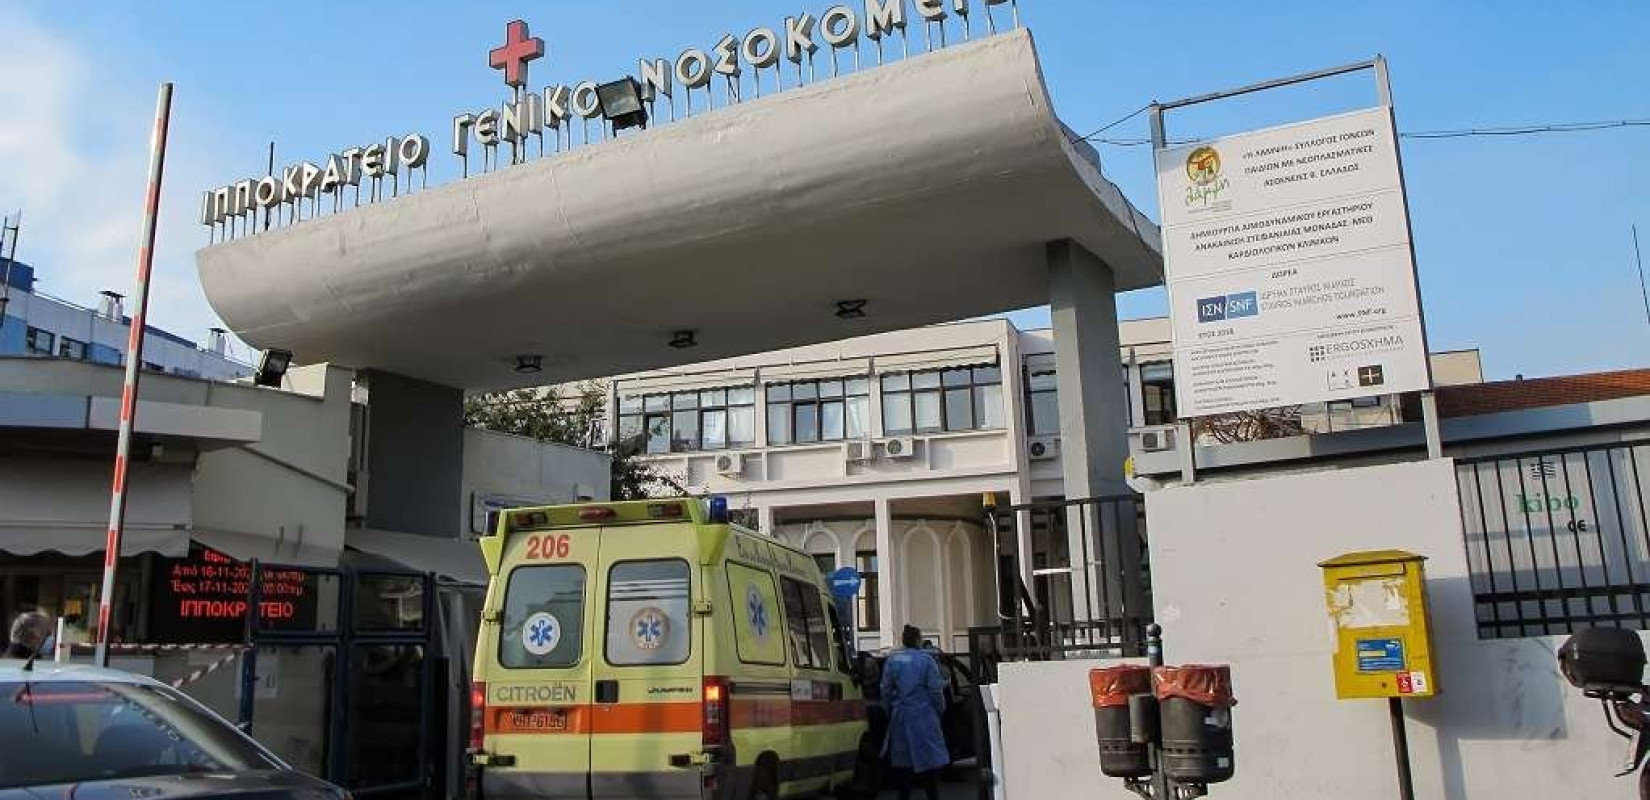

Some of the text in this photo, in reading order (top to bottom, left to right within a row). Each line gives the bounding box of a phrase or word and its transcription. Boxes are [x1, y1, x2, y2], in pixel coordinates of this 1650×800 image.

[202, 133, 430, 226] ΙΠΠΟΚΡΑΤΕΙΟ
[453, 81, 600, 155] ΓΕΝΙΚΟ
[1202, 301, 1222, 317] ΙΣΝ
[1229, 298, 1253, 313] SNF
[526, 534, 570, 559] 206
[180, 599, 294, 618] ΙΠΠΟΚΡΤΕΙΟ
[496, 681, 576, 701] CITROËN
